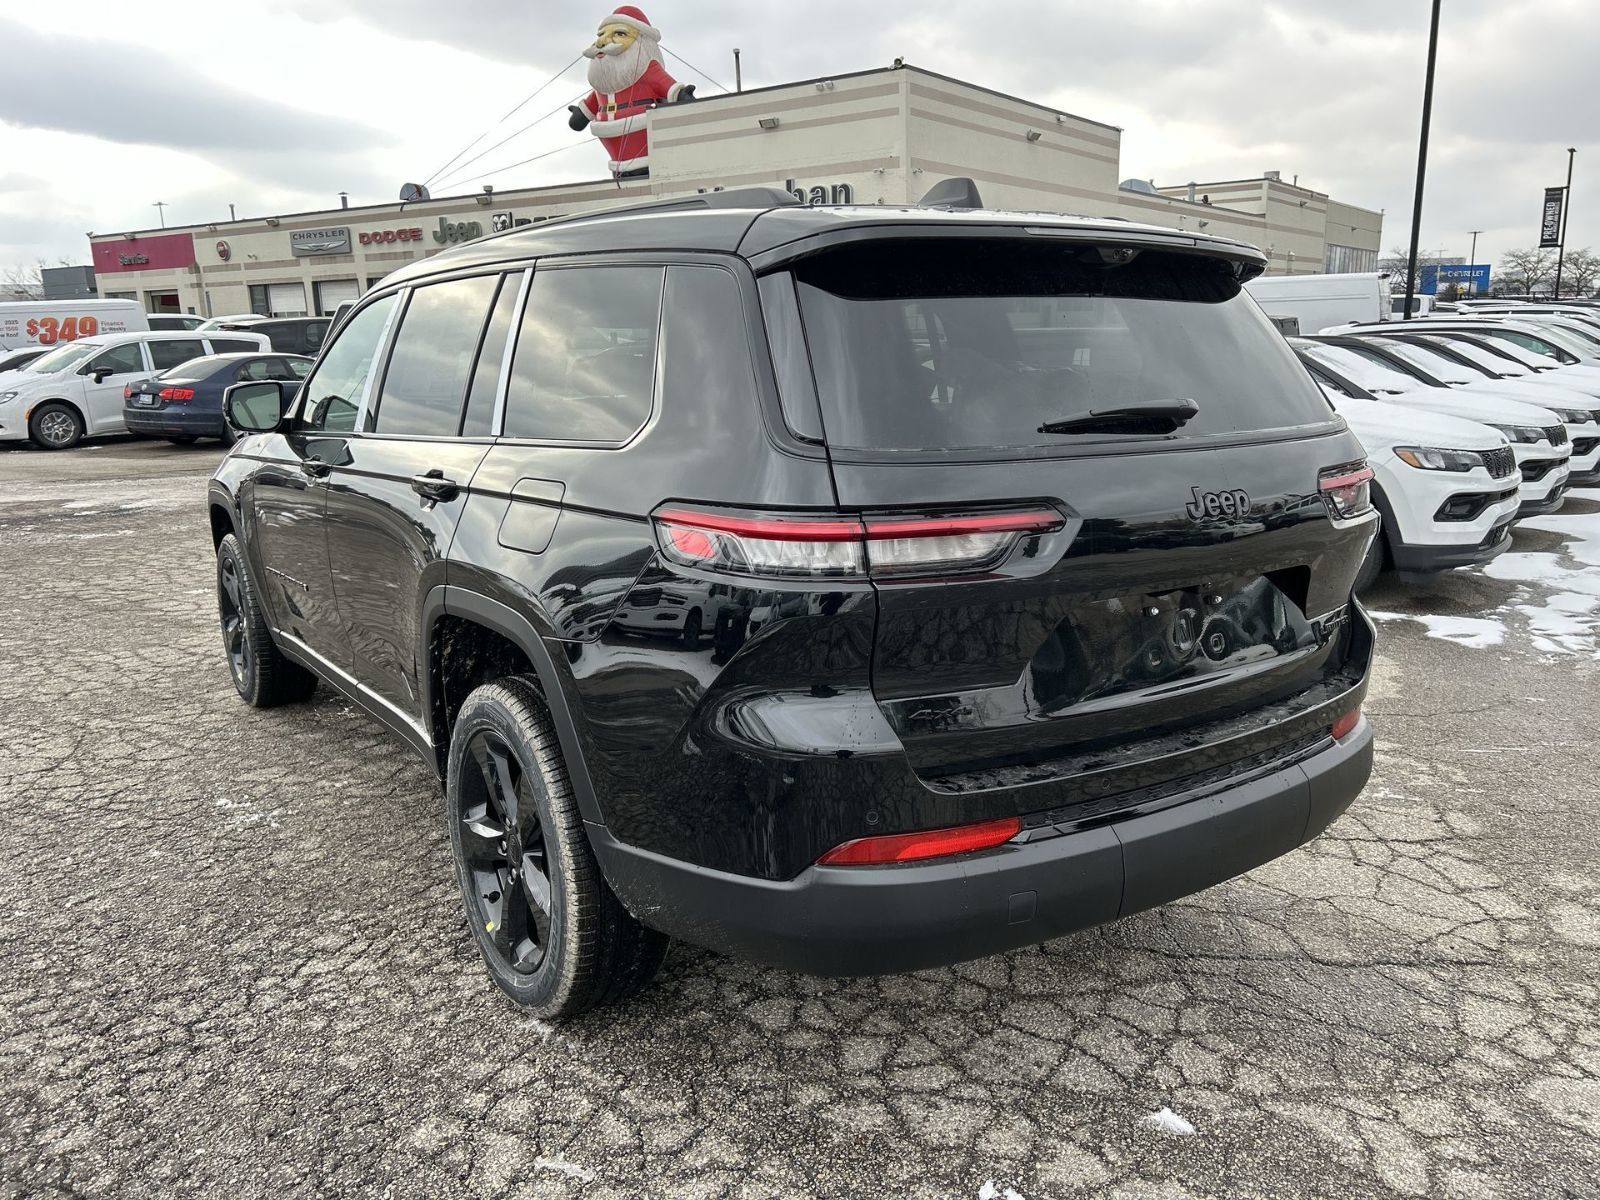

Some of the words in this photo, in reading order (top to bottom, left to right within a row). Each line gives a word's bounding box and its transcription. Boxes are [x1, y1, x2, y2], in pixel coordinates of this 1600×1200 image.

[432, 217, 482, 244] Jeep
[1542, 201, 1556, 240] PRE-OWNED
[292, 229, 345, 241] CHRYSLER
[358, 227, 423, 245] DODGE
[26, 316, 98, 346] $349
[1186, 486, 1251, 523] Jeep
